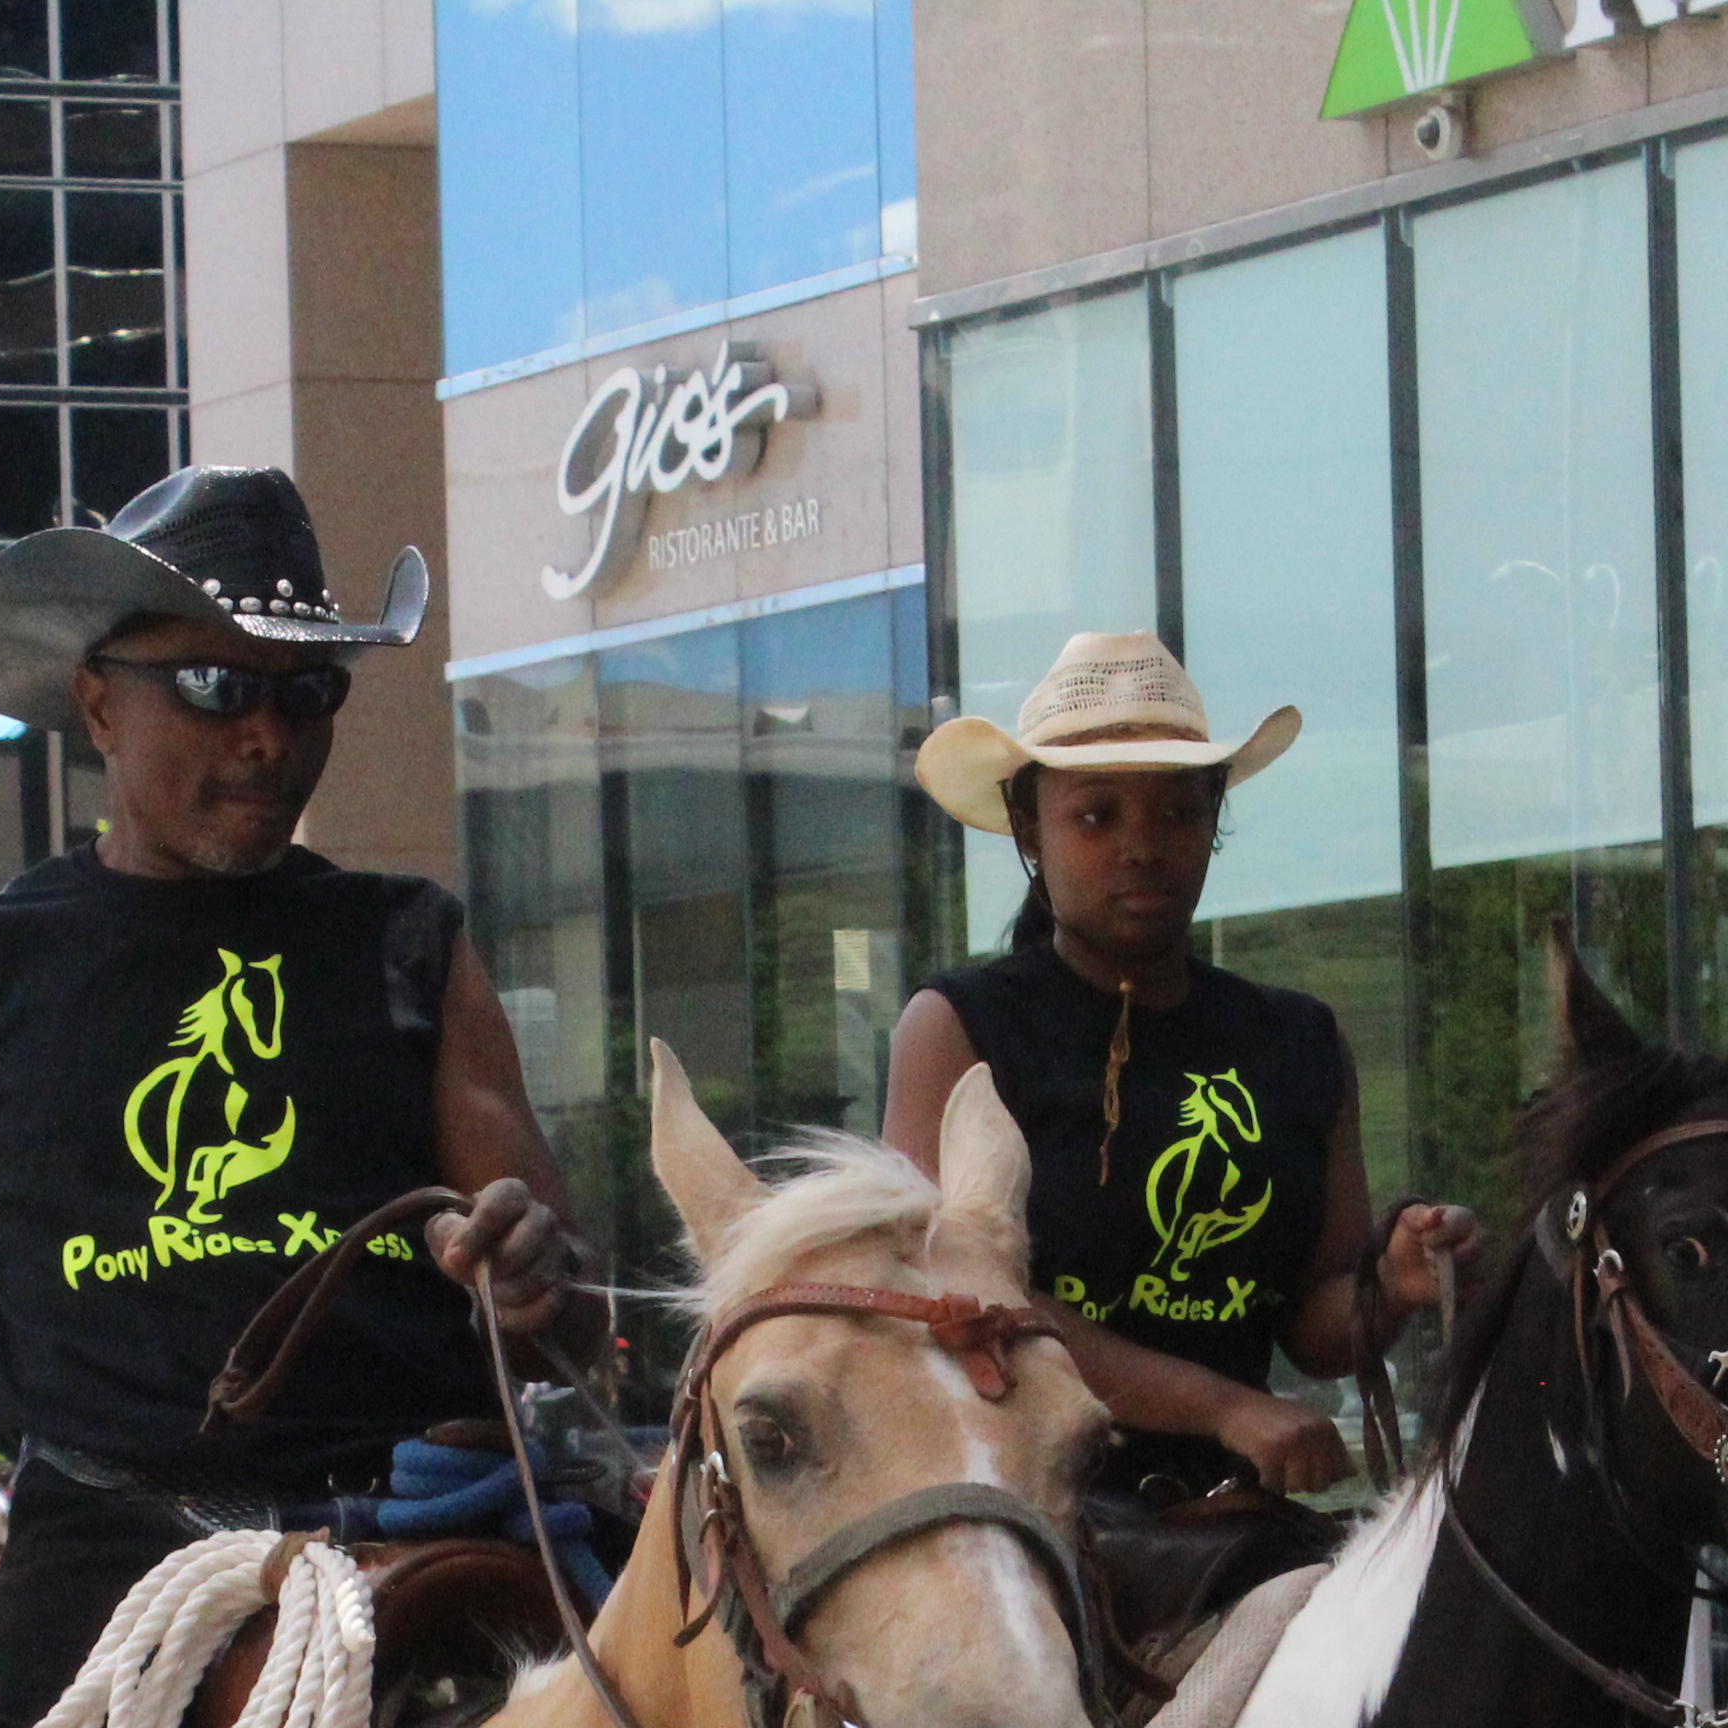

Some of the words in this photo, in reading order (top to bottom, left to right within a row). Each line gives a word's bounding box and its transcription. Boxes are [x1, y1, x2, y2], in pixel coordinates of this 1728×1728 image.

[648, 512, 761, 569] RISTORANTE
[765, 508, 778, 546] &
[782, 498, 820, 542] BAR
[62, 1234, 148, 1290] Pony
[1129, 1274, 1215, 1322] Rides
